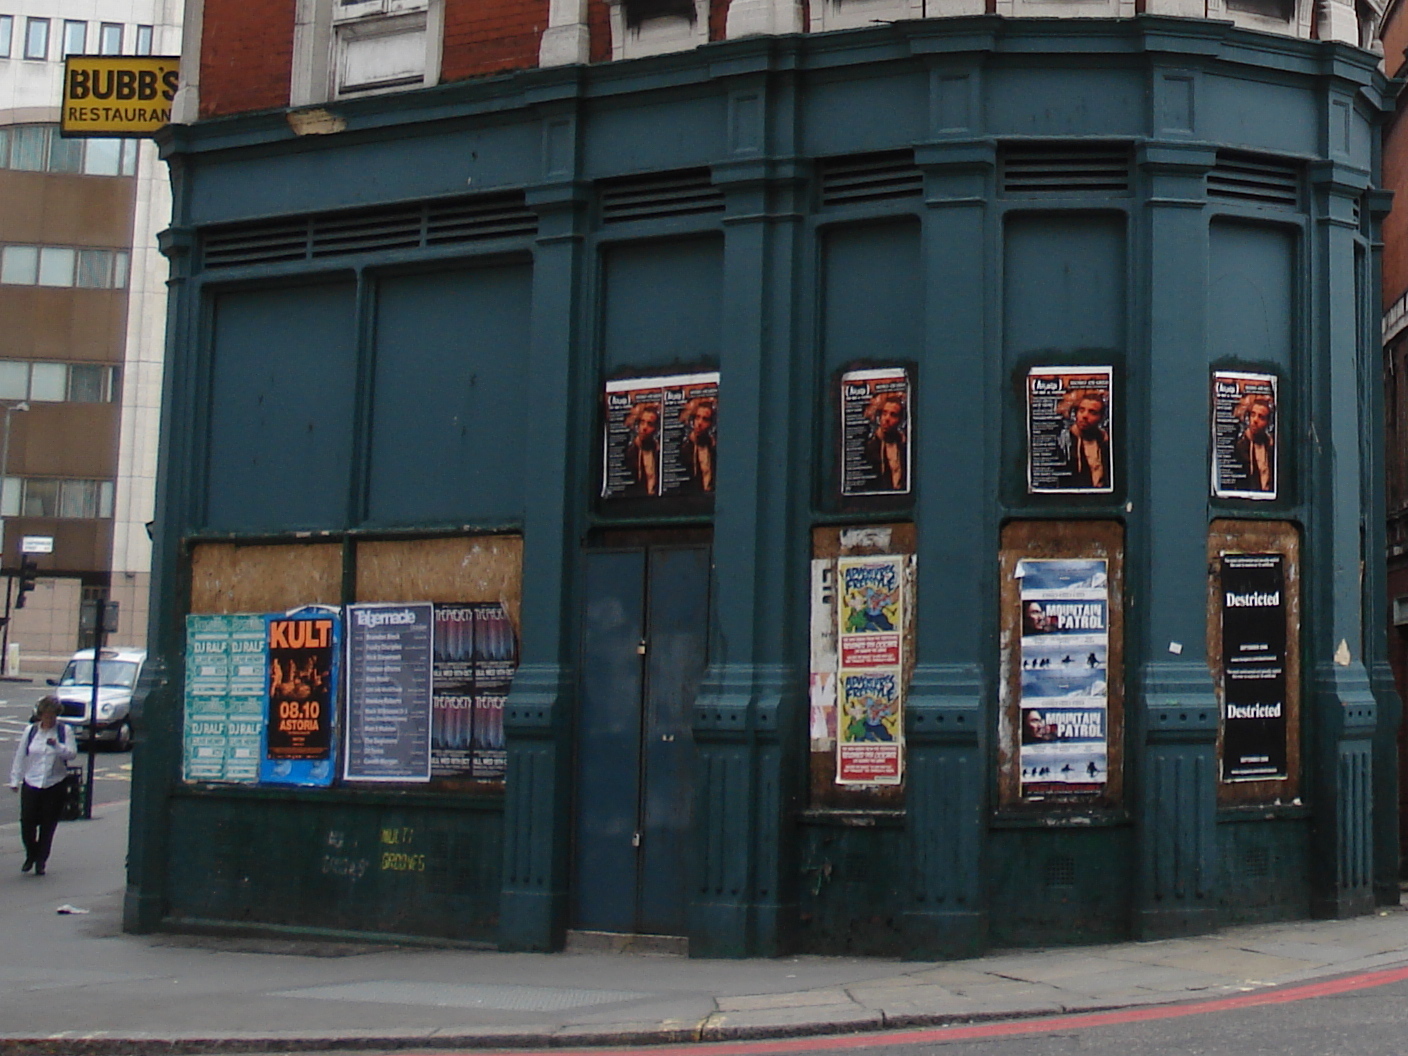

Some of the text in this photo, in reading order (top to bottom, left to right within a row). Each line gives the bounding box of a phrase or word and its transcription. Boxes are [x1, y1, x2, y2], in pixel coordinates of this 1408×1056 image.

[70, 67, 179, 102] BUBB'S
[69, 107, 172, 123] RESTAURAN
[1226, 591, 1280, 607] Destricted
[1045, 604, 1102, 617] MOUNTAIN
[354, 609, 416, 628] Tabernacle
[1057, 616, 1104, 629] PATROL
[269, 620, 332, 649] KULT
[194, 641, 227, 653] DJ RALF
[231, 641, 265, 653] DJ RALF
[279, 701, 320, 719] 08.10
[1227, 702, 1281, 719] Destricted
[1045, 712, 1101, 724] MOUNTAIN
[192, 723, 224, 735] DJ RALF
[229, 723, 262, 735] DJ RALF
[279, 719, 319, 731] ASTORIA
[1057, 724, 1104, 738] PATROL
